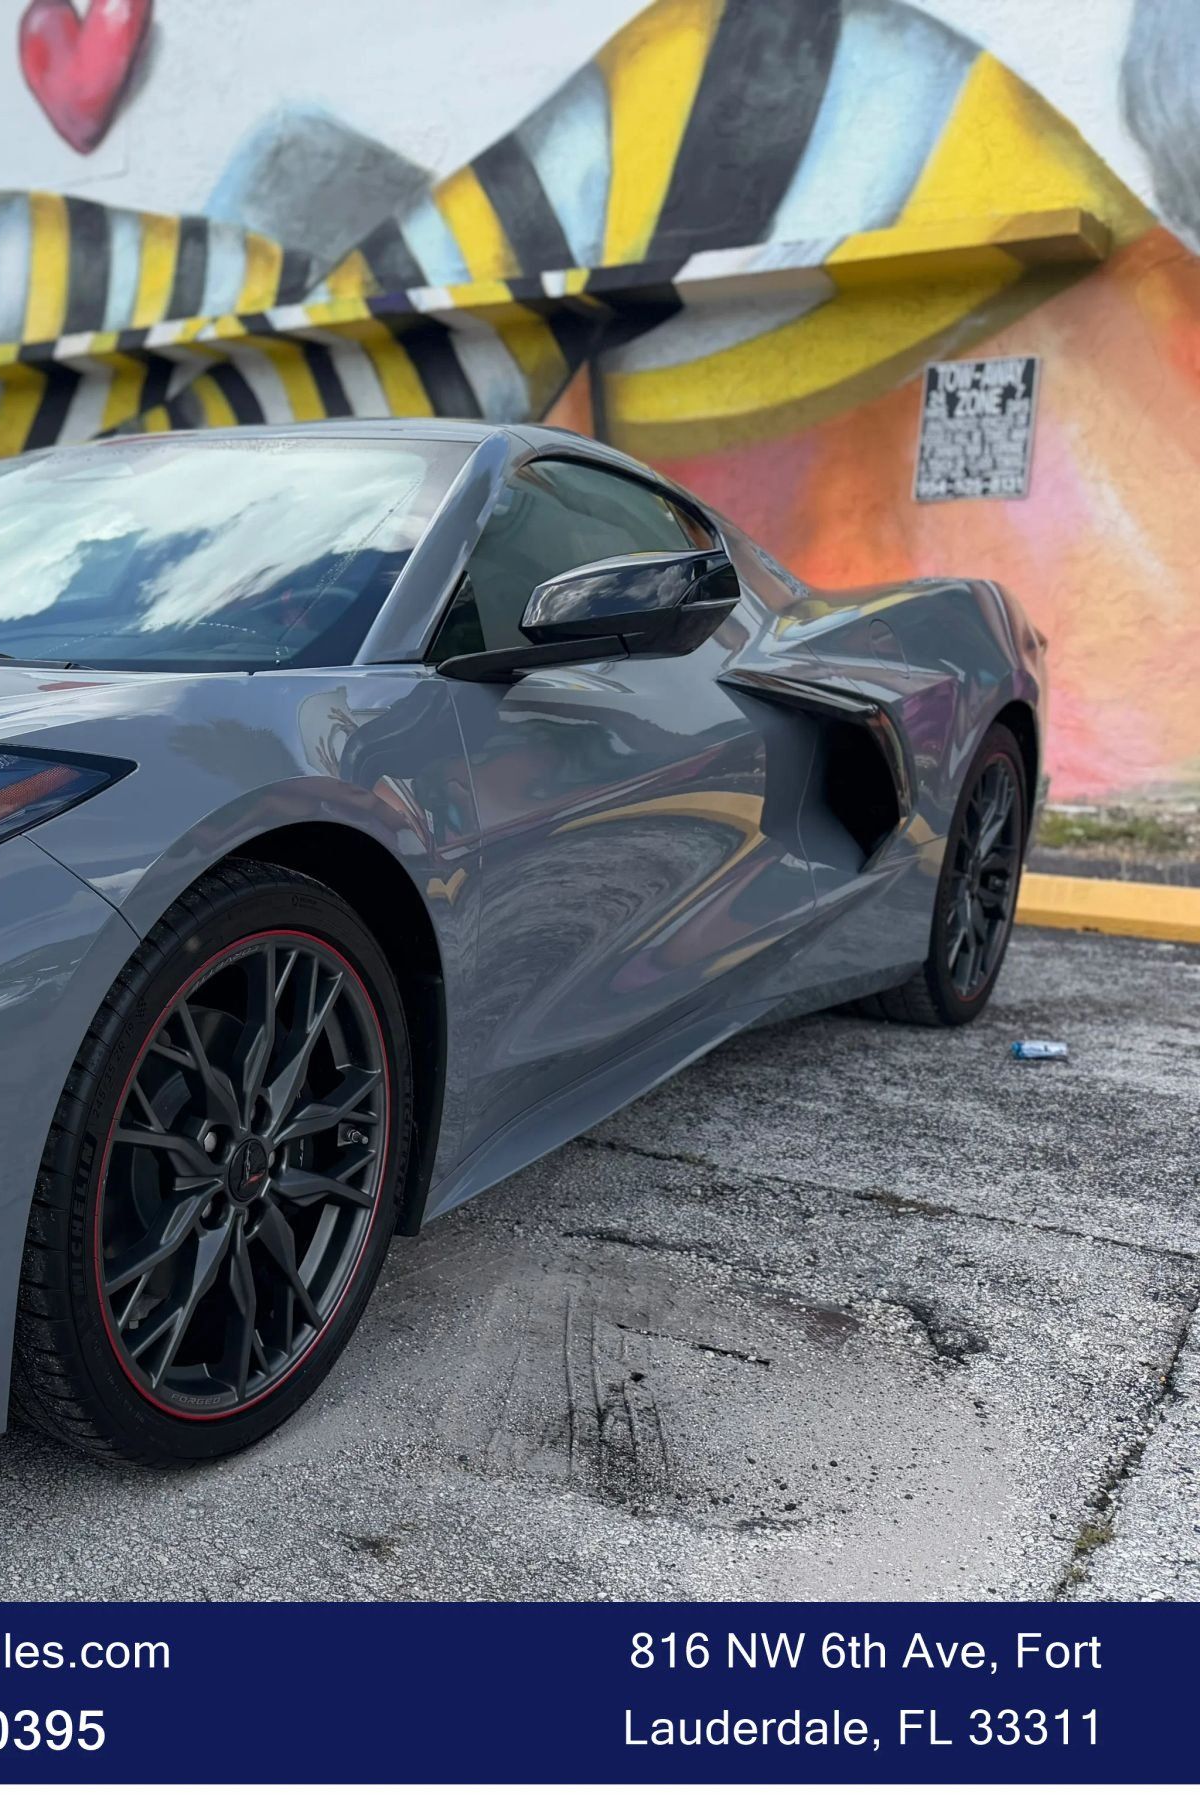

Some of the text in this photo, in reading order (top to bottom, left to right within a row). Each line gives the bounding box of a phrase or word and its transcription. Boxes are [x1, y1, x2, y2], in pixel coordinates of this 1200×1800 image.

[937, 361, 1026, 393] TOW-AWAY
[954, 387, 1004, 417] ZONE
[72, 1141, 95, 1296] MICHELIN
[171, 1393, 221, 1405] FORGED
